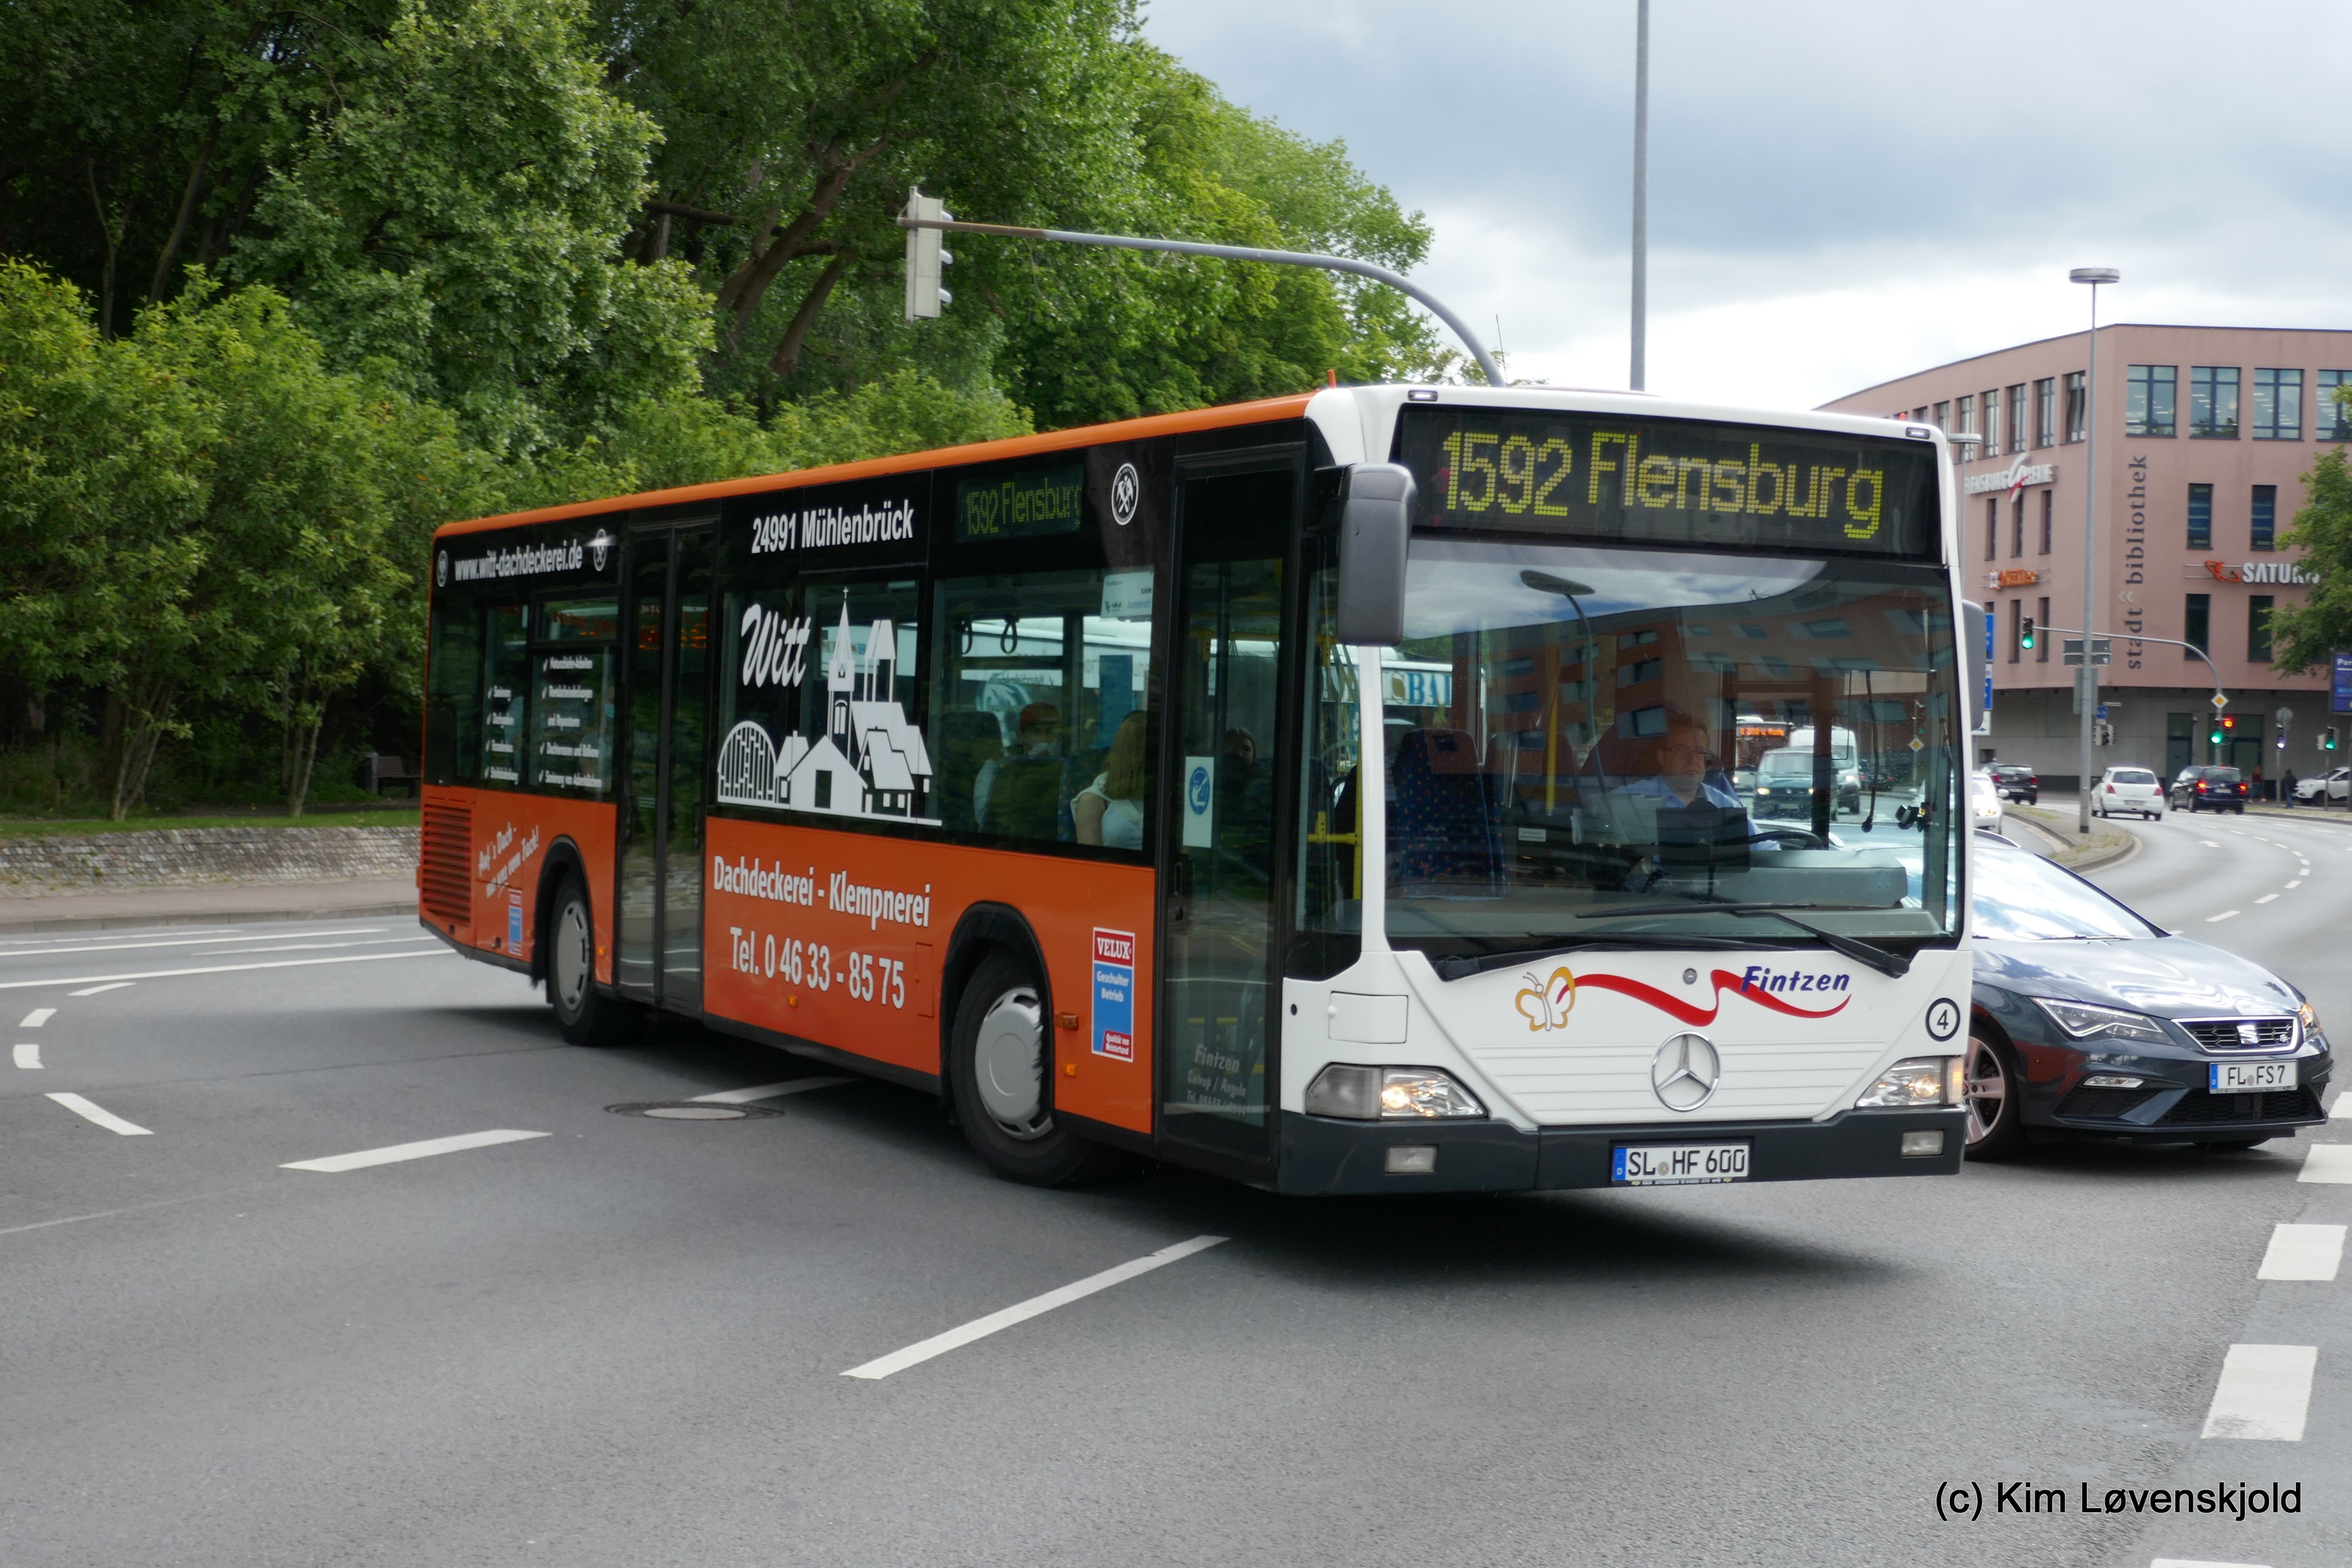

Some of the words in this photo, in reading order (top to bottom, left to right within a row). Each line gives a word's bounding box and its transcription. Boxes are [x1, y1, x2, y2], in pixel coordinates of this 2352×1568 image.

[1442, 431, 1572, 516] 1592
[1588, 432, 1883, 539] Flensburg
[752, 513, 796, 554] 24991
[801, 499, 914, 548] Mühlenbrück
[967, 490, 999, 535] 1592
[2125, 454, 2147, 585] bibliothek
[454, 538, 582, 581] www.witt-dachdeckerei.de
[741, 604, 811, 688] Witt
[2125, 608, 2143, 669] stadt
[714, 856, 814, 907] Dachdeckerei
[829, 870, 930, 930] Klempnerei
[730, 927, 759, 975] Tel.
[1097, 937, 1131, 960] VELUX
[1097, 970, 1129, 986] Geschulter
[1101, 987, 1124, 1003] Betrieb
[1740, 966, 1850, 992] Fintzen
[1937, 1009, 1948, 1030] 4
[1194, 1042, 1240, 1074] Fintzen
[2228, 1067, 2246, 1085] FL
[1628, 1151, 1656, 1175] SL
[1672, 1150, 1700, 1175] HF
[1706, 1148, 1745, 1174] 600
